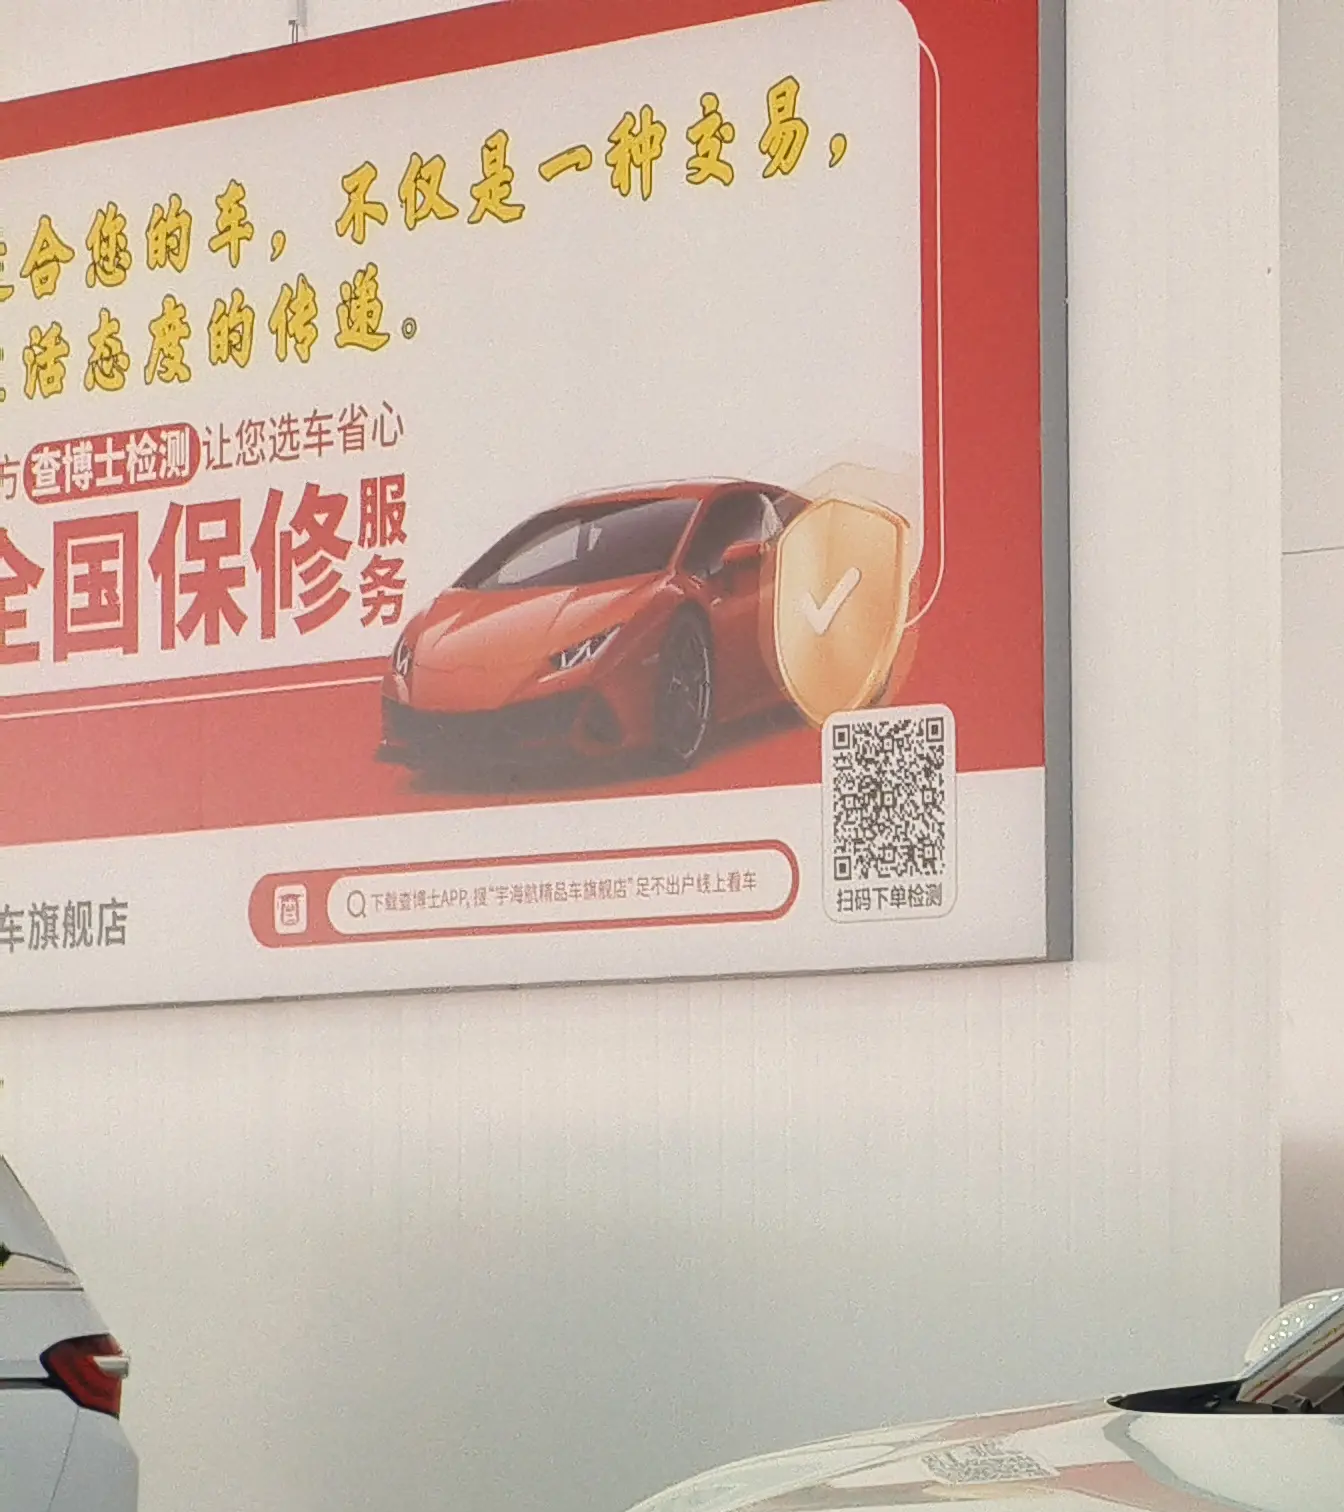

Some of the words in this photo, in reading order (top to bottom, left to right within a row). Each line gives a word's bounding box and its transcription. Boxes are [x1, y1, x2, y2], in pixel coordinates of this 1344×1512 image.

[0, 76, 848, 300] 合您的车，不仅是一种交易，
[0, 264, 417, 399] 活态度的传递。
[32, 430, 191, 497] 查博士检测
[202, 400, 404, 471] 让您选车省心
[0, 896, 128, 952] 车旗舰店
[836, 882, 942, 912] 扫码下单检测
